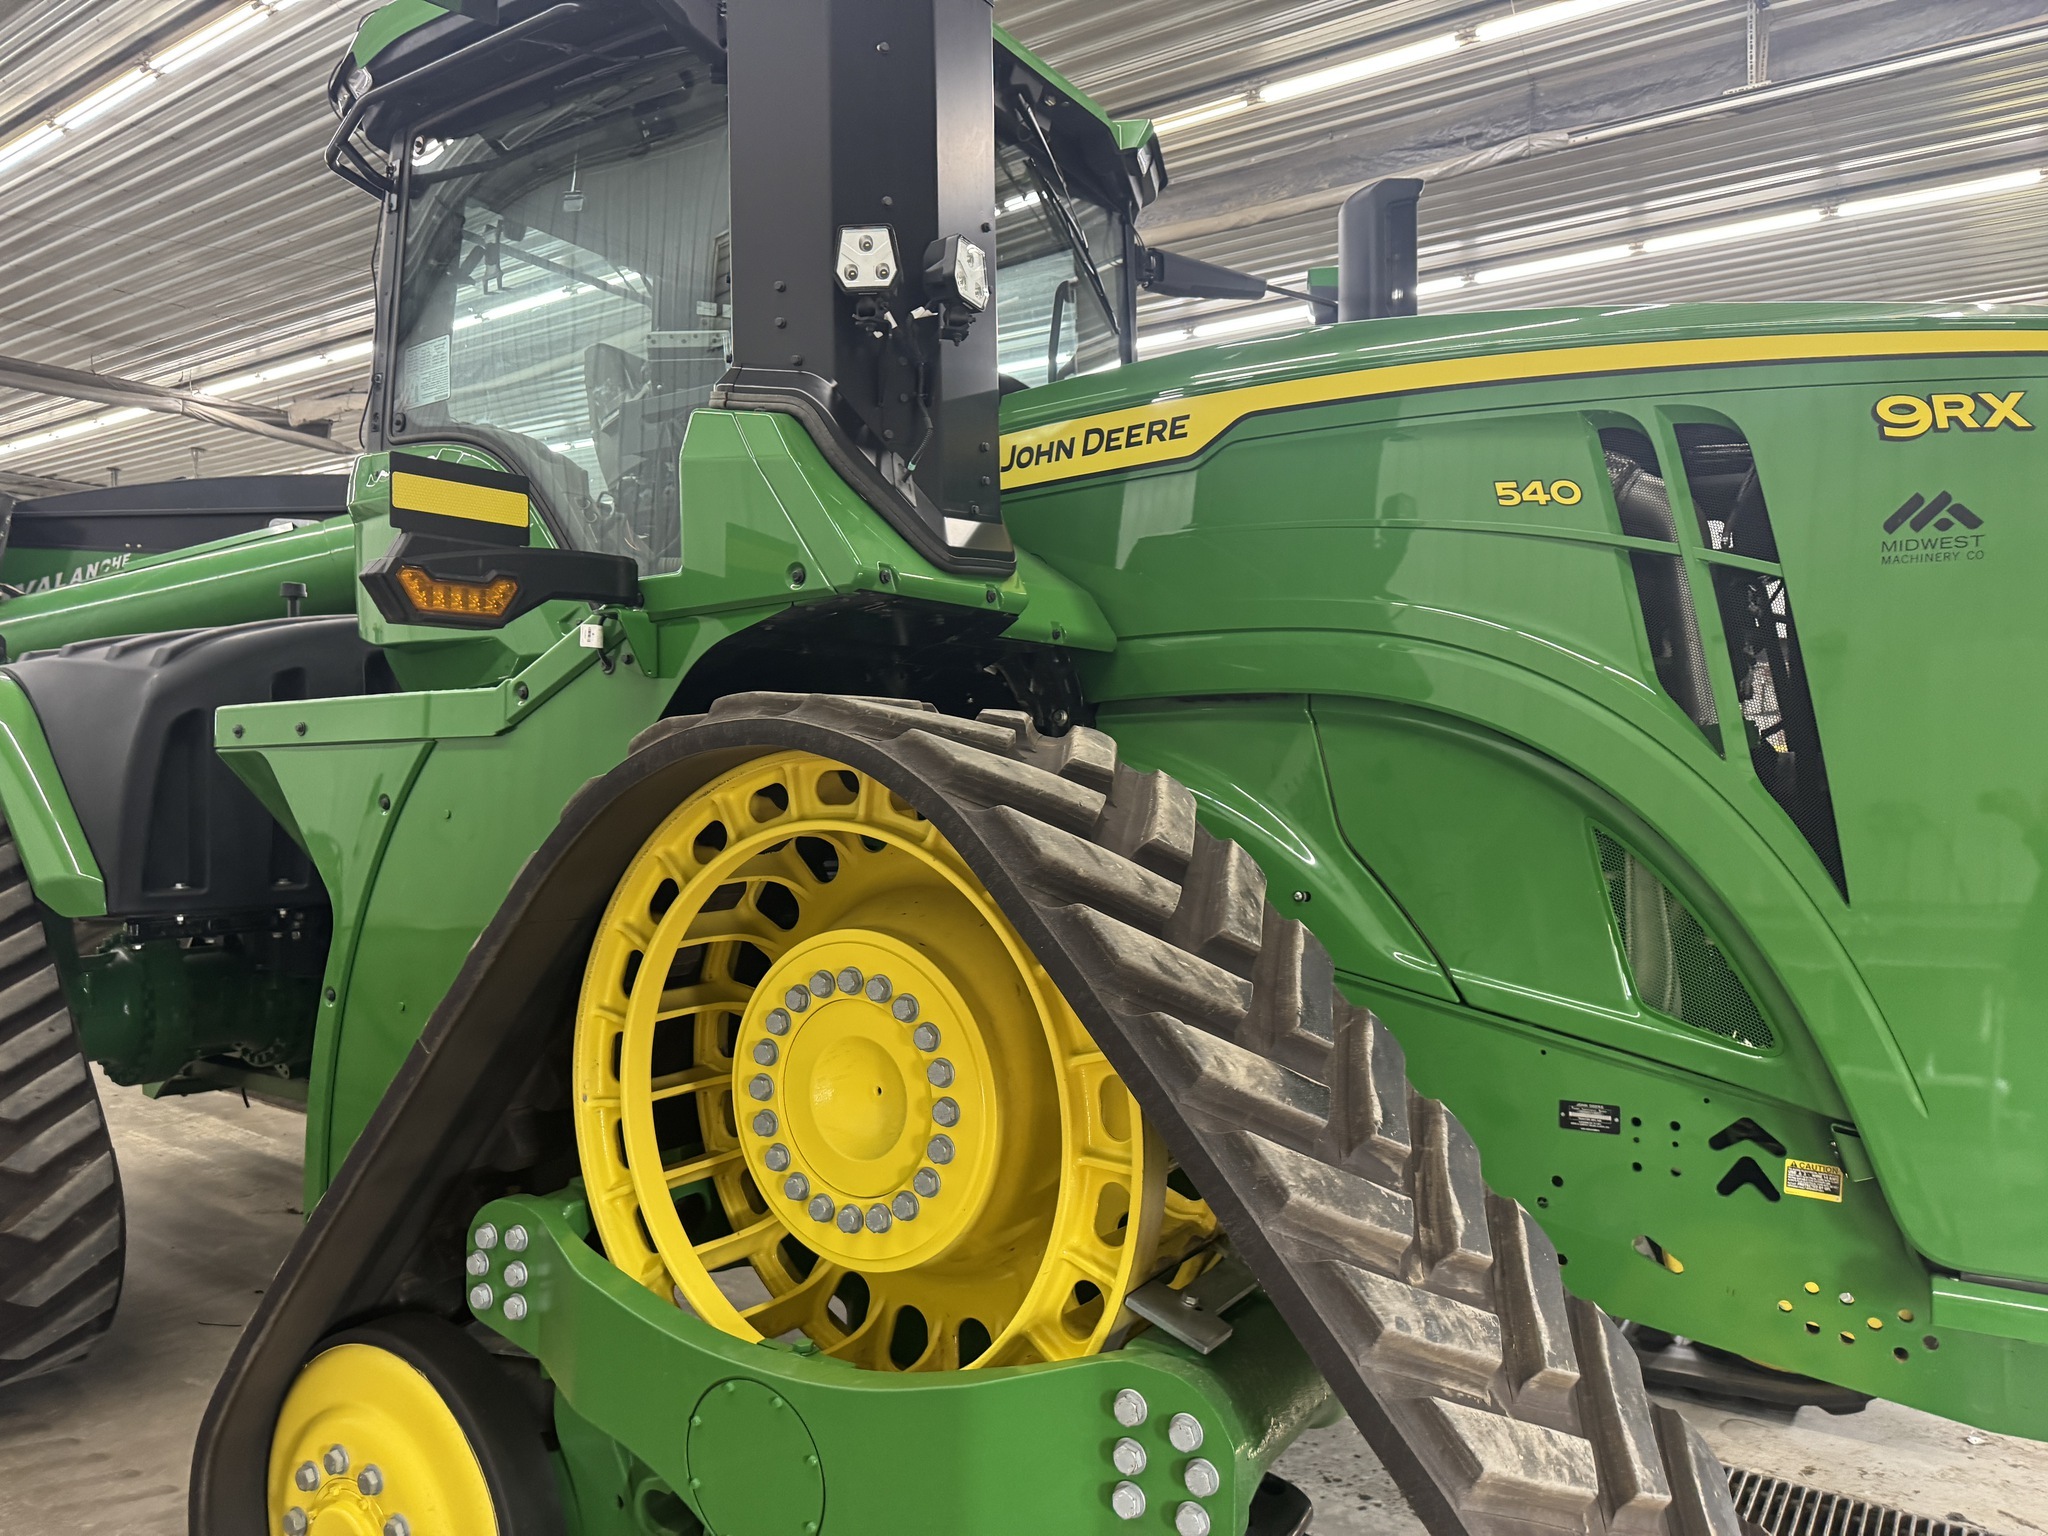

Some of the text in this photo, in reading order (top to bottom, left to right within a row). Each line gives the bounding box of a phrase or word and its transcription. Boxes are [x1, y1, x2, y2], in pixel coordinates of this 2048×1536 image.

[1871, 391, 2036, 441] 9RX
[1000, 414, 1191, 472] JOHN DEERE
[1494, 479, 1582, 507] 540
[1881, 534, 1986, 553] MIDWEST
[1881, 550, 1985, 565] MACHINERY CO
[1799, 1162, 1840, 1174] CAUTION
